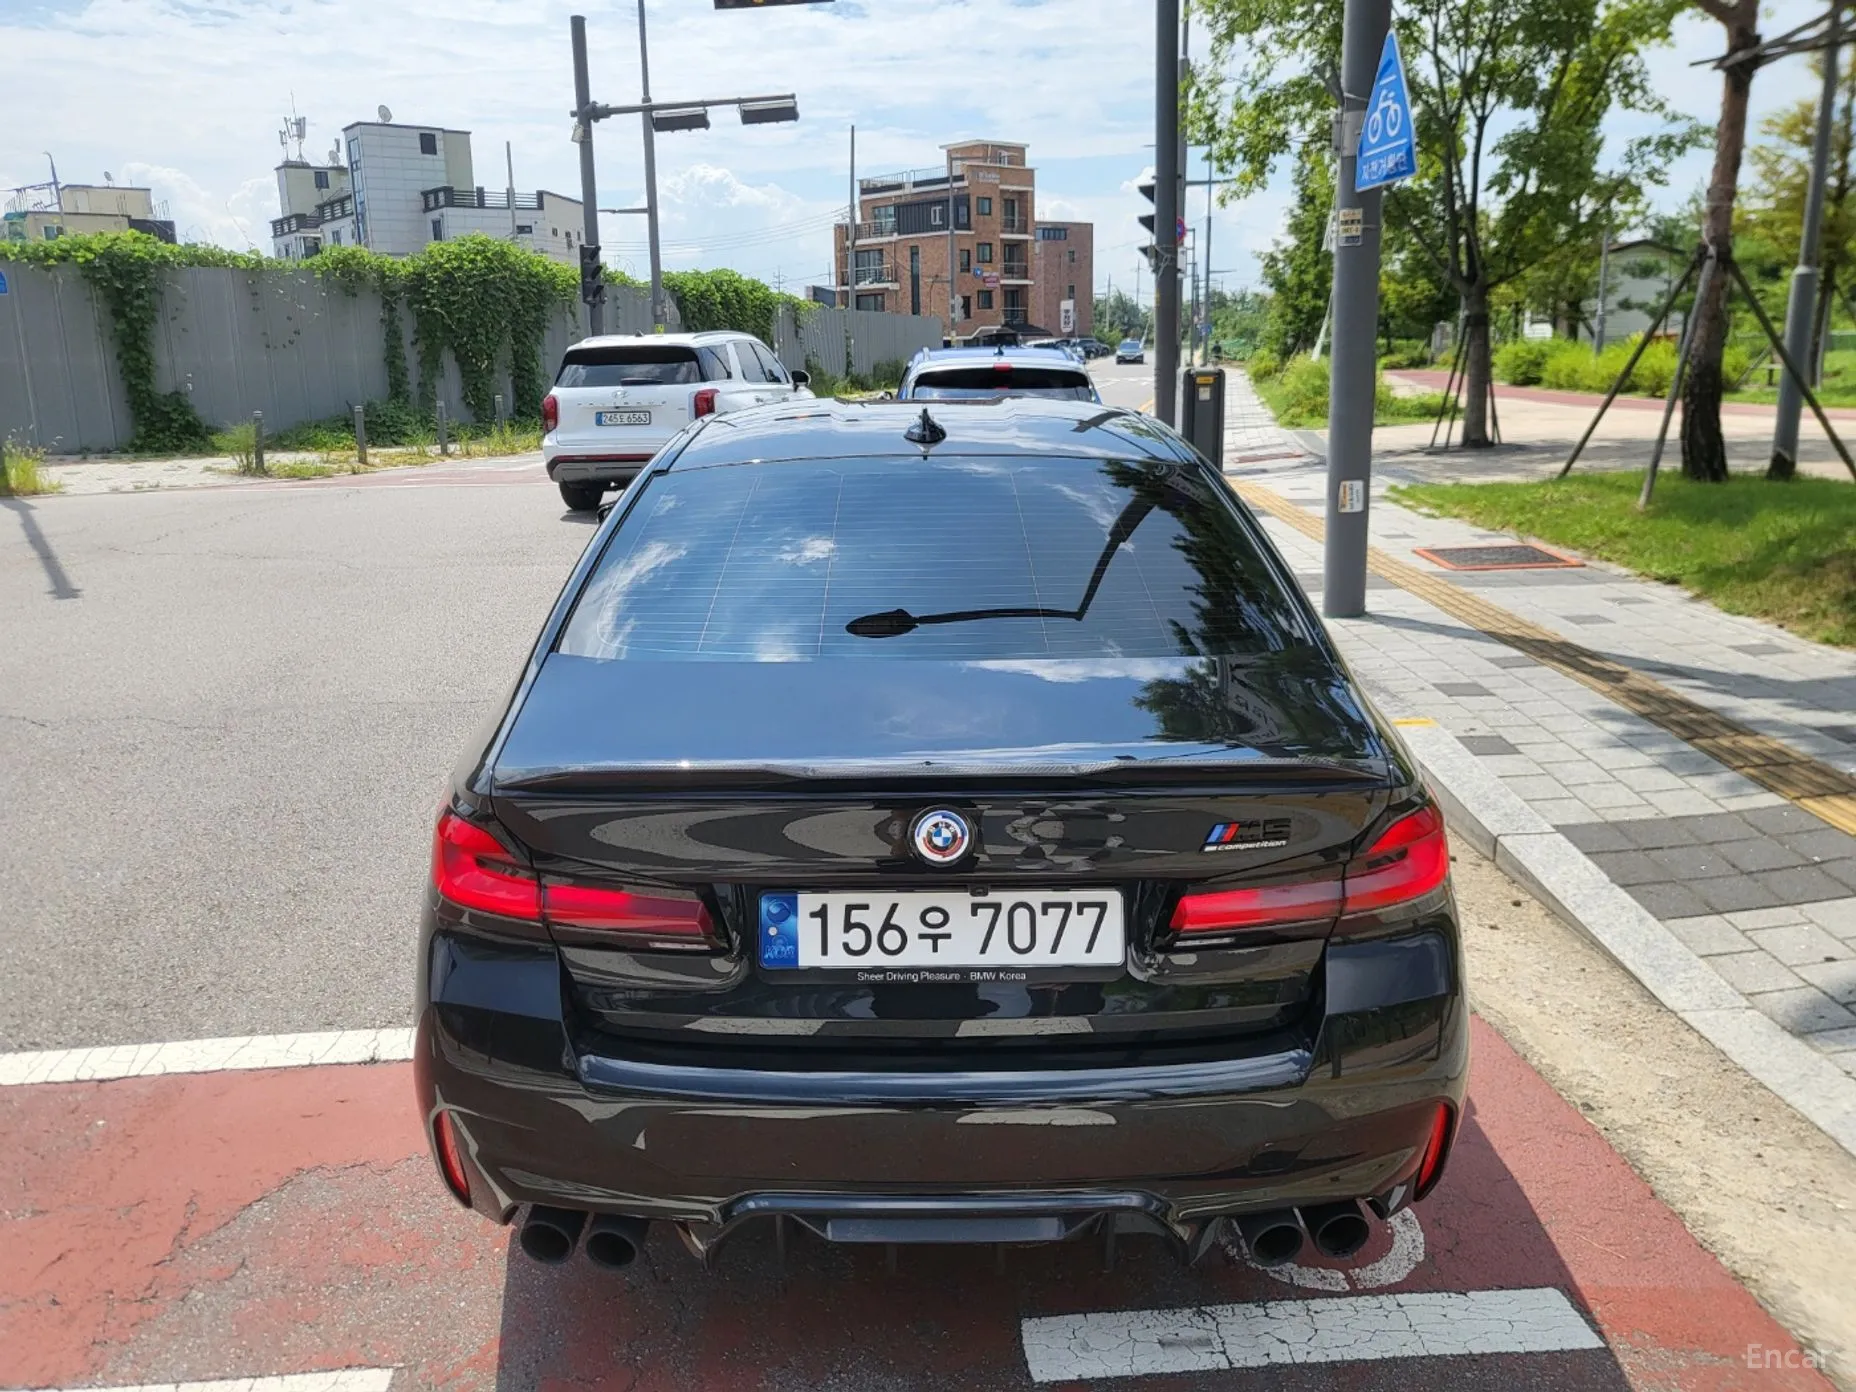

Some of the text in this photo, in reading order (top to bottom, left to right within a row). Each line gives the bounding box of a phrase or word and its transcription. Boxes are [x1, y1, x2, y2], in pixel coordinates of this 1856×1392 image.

[1217, 840, 1287, 852] competition
[809, 901, 1108, 957] 156우 7077
[857, 971, 1026, 982] Sheer Driving Pleasure BMW Korea
